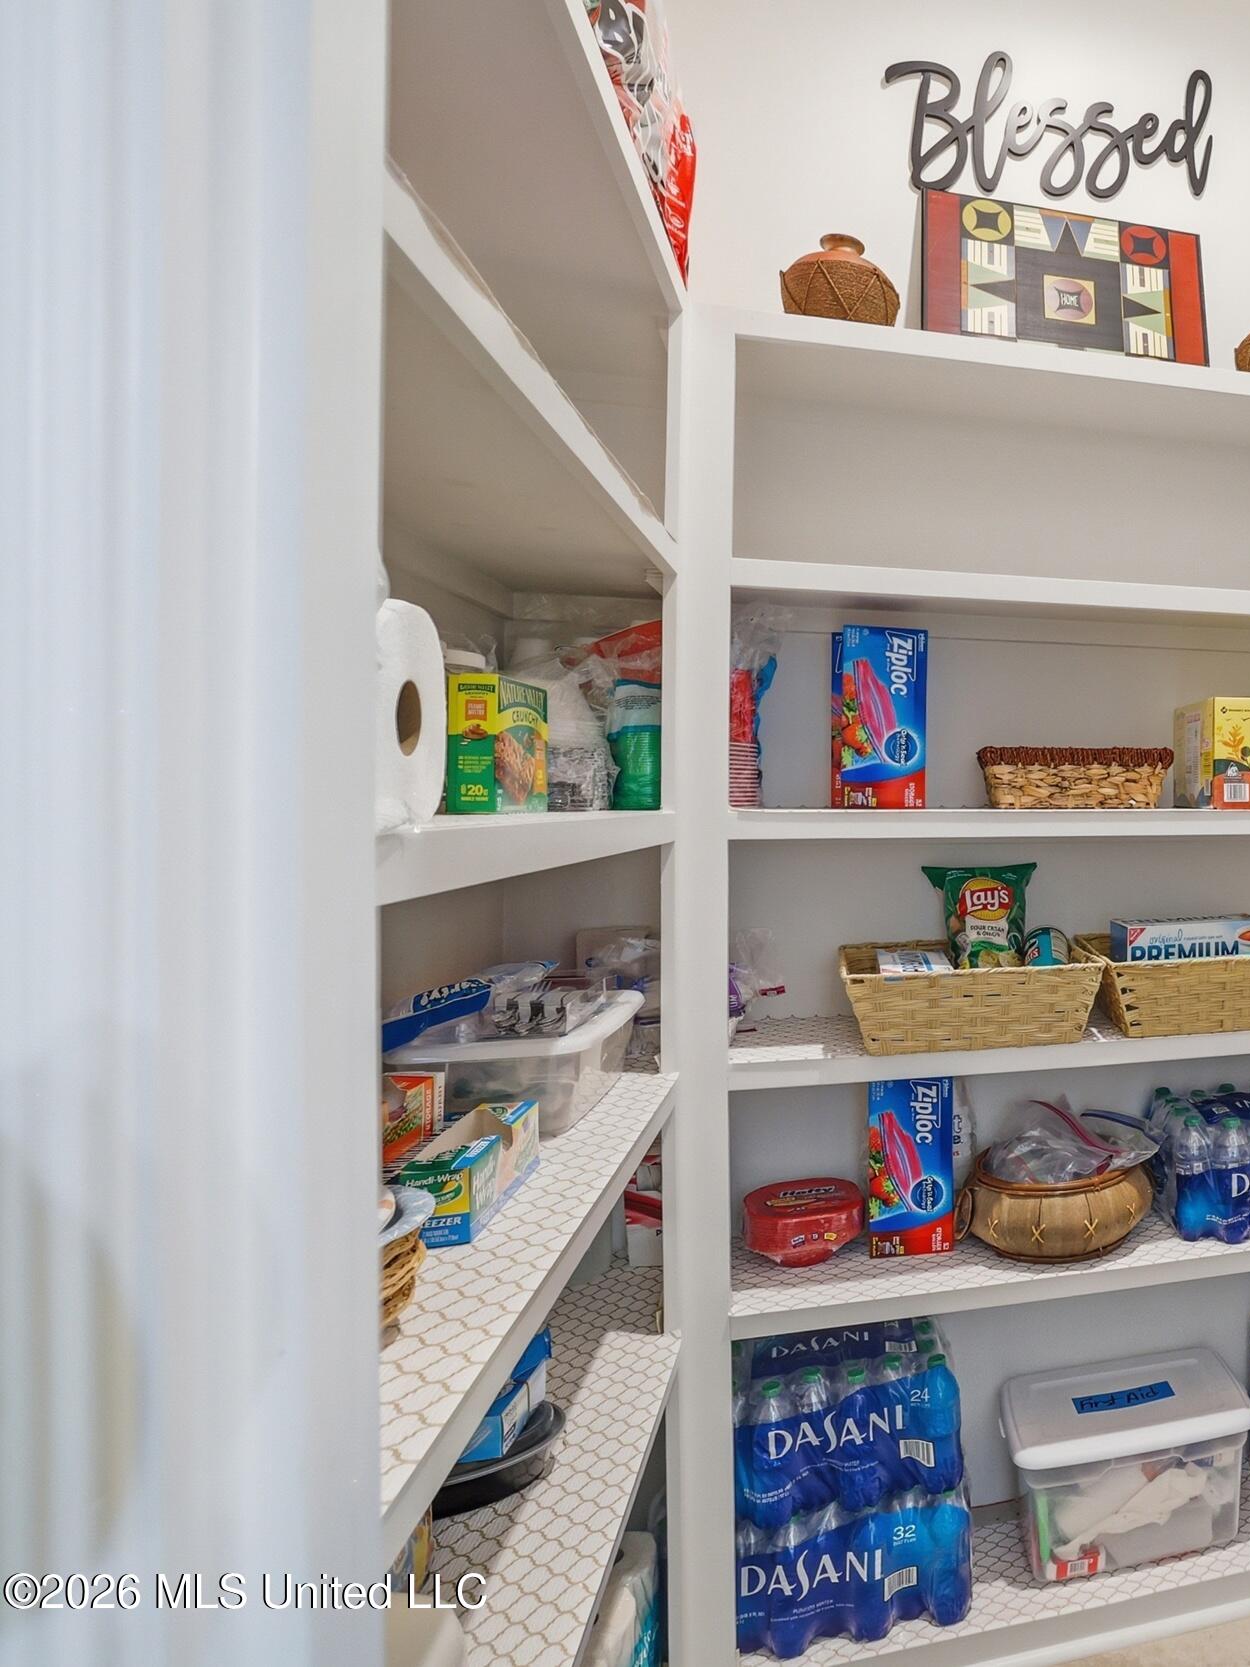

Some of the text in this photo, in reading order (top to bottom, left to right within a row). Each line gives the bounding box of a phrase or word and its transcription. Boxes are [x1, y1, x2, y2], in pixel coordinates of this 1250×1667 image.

[884, 50, 1213, 198] Blessed
[1060, 293, 1080, 307] HOME
[885, 636, 912, 695] Ziploc
[512, 711, 539, 725] CRUNCHY
[964, 886, 1010, 913] Lay's
[1149, 928, 1184, 945] original
[1131, 940, 1240, 962] PREMIUM
[910, 1085, 938, 1144] Ziploc
[405, 1172, 464, 1188] Handi-Wrap
[771, 1331, 869, 1359] DASANI
[911, 1388, 930, 1402] 24
[1079, 1386, 1160, 1411] First Aid
[768, 1404, 904, 1460] DASANI
[893, 1525, 916, 1540] 32
[740, 1549, 883, 1602] DASANI
